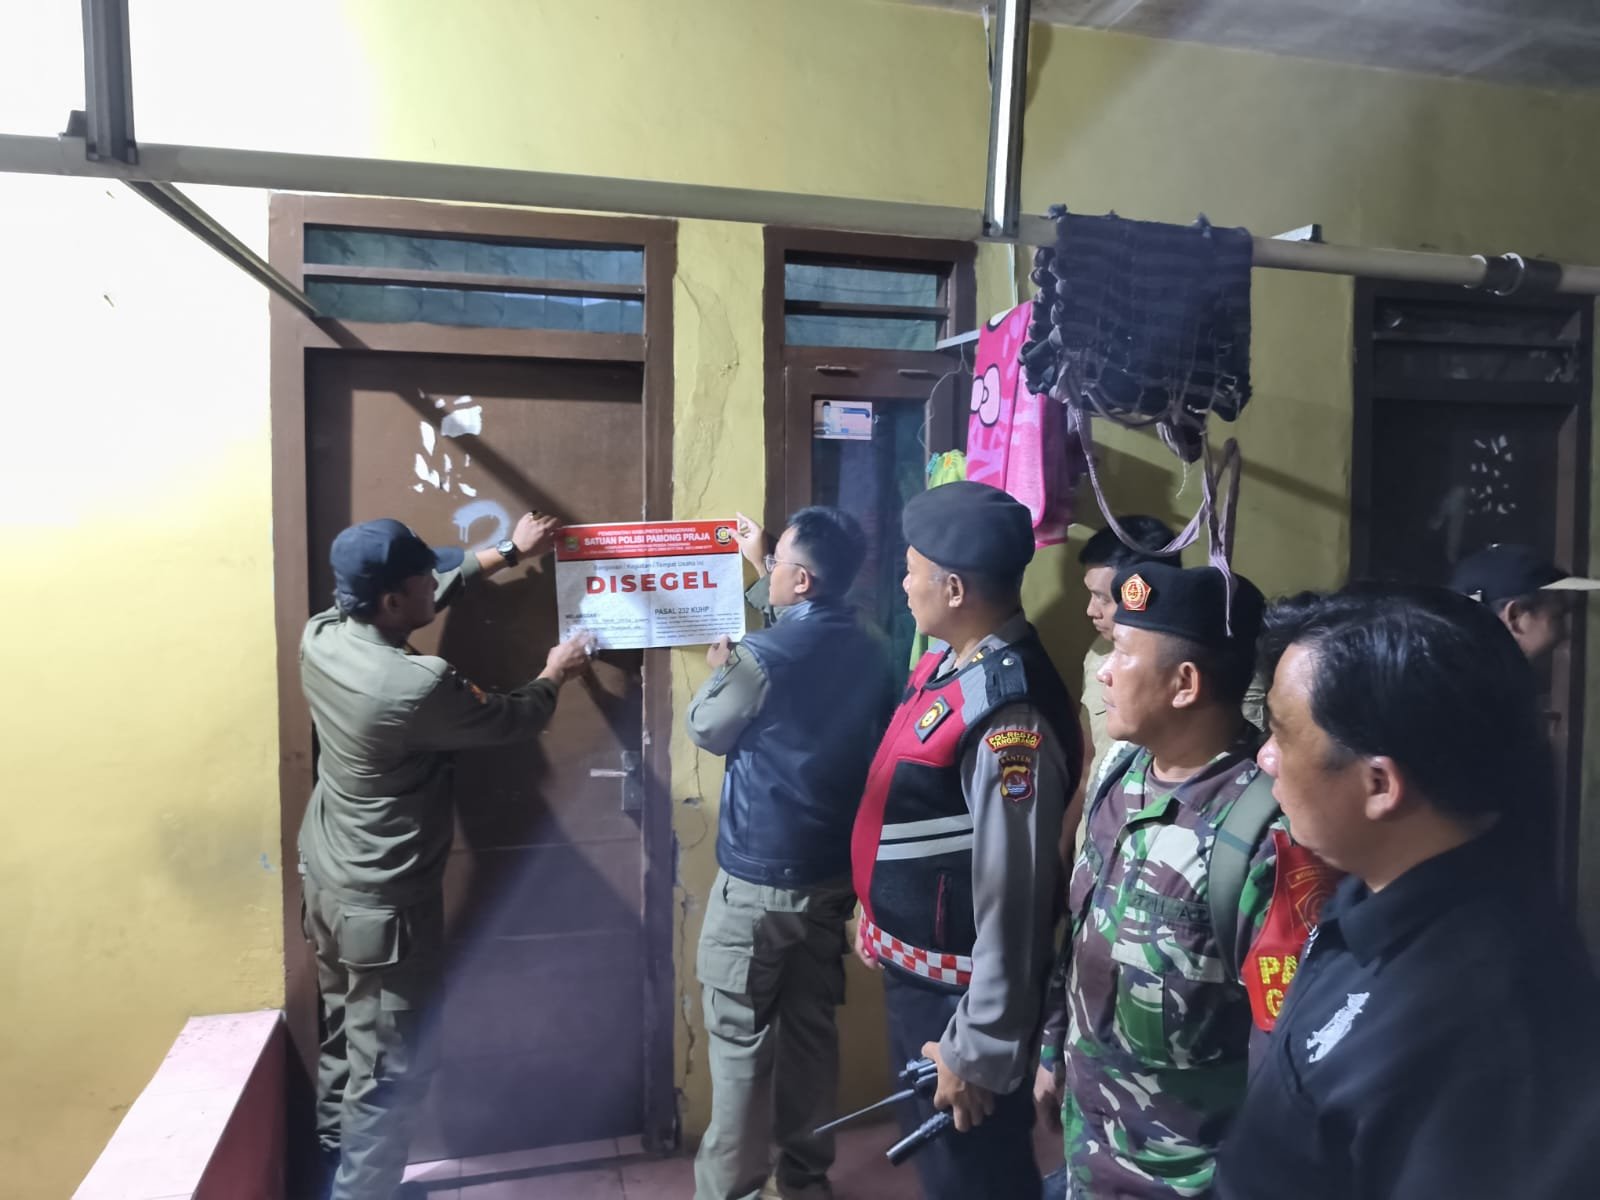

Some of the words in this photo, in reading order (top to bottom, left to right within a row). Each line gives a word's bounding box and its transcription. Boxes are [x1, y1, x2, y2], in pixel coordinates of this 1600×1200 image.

[584, 535, 617, 546] SATUAN
[618, 534, 645, 545] POLISI
[646, 533, 682, 543] PAMONG
[683, 532, 710, 541] PRAJA
[586, 571, 718, 594] DISEGEL
[654, 607, 677, 615] PASAL
[988, 731, 1037, 745] POLRESTA
[1001, 755, 1031, 763] BANTEN
